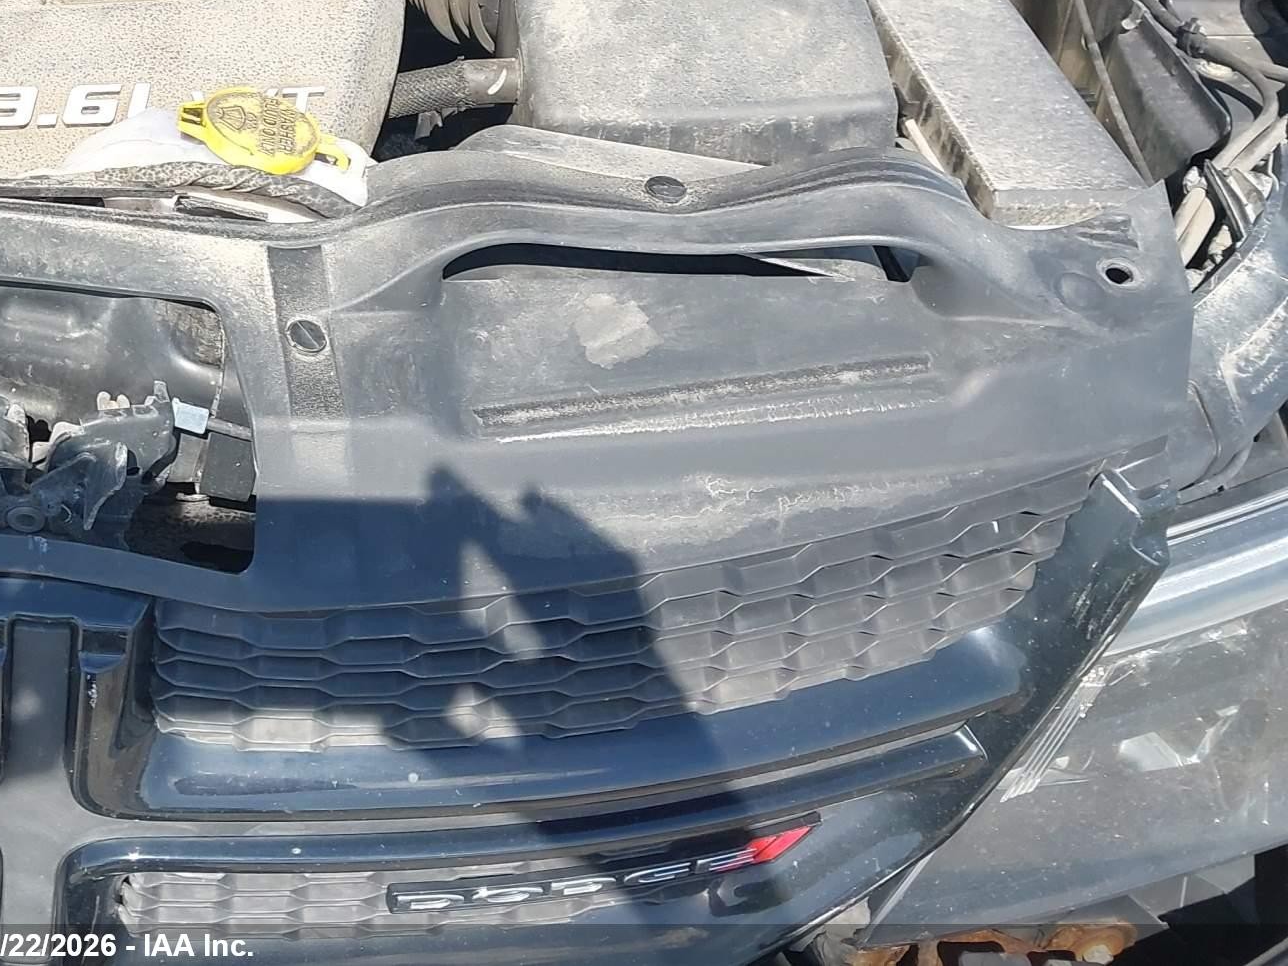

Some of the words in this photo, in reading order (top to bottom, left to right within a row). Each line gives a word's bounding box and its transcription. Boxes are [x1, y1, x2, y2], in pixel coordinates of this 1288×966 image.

[263, 97, 281, 126] FLUID
[260, 127, 276, 156] ONLY
[278, 108, 297, 155] WASHER
